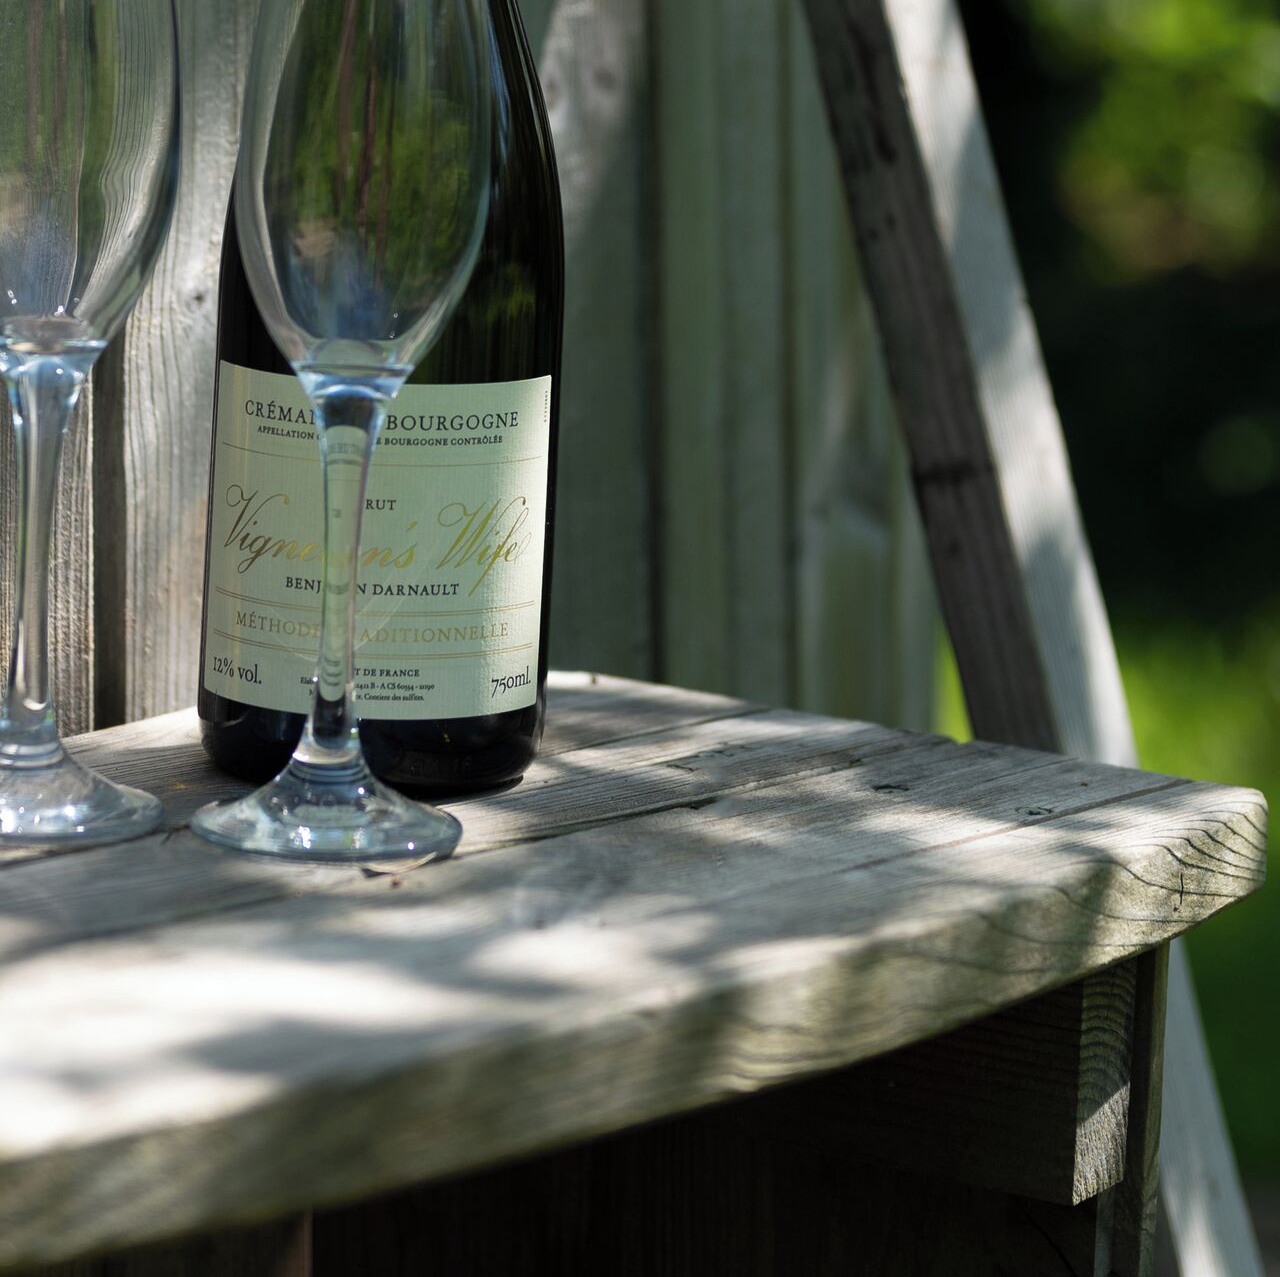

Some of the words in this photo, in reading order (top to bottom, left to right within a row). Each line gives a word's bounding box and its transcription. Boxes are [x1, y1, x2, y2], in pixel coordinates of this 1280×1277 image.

[245, 400, 316, 425] CRÉMA
[386, 411, 519, 431] BOURGOGNE
[257, 425, 315, 440] APPELLATION
[384, 437, 448, 446] BOURGOGNE
[451, 435, 503, 446] CONTRÔLÉE
[365, 499, 397, 510] RUT
[436, 496, 532, 597] Wife
[285, 576, 367, 596] BENJN
[372, 583, 459, 596] DARNAULT
[236, 611, 320, 638] MÉTHODE
[360, 622, 508, 643] ADITIONNELLE
[213, 656, 234, 678] 12%
[238, 664, 262, 685] vol.
[363, 669, 377, 677] DE
[380, 669, 420, 677] FRANCE
[490, 665, 531, 698] 750ml.
